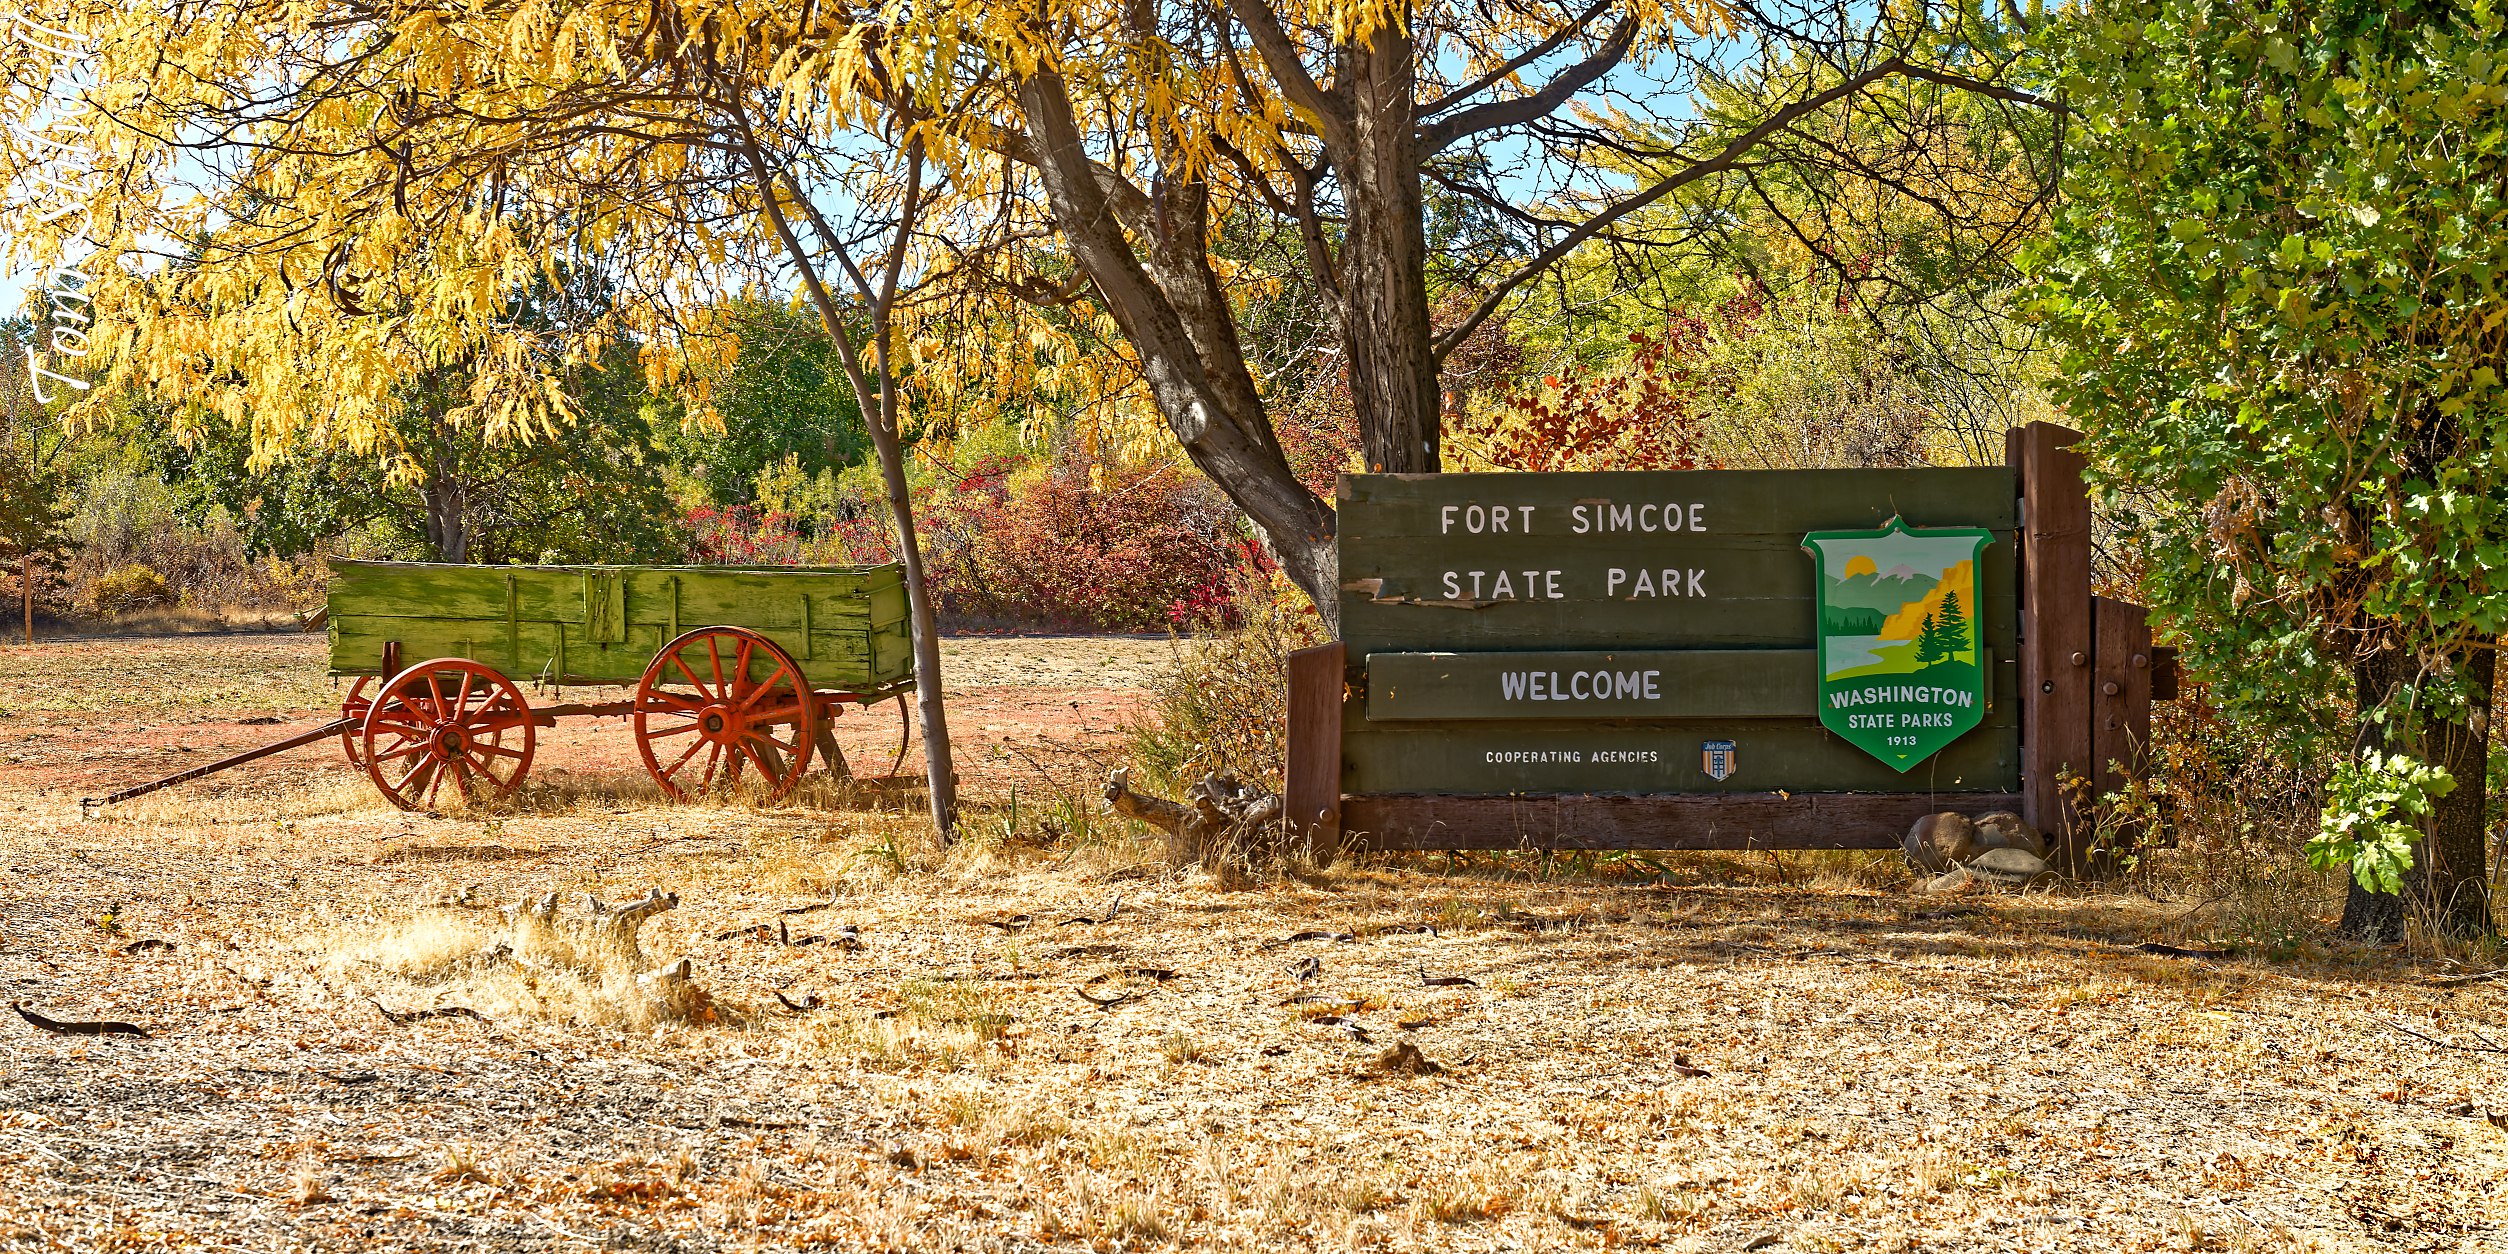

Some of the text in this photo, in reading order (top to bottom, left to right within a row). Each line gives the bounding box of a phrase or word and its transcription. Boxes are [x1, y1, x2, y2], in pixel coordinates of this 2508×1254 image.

[1441, 503, 1707, 534] FORT SIMCOE
[1442, 568, 1707, 599] STATE PARK
[1501, 670, 1661, 701] WELCOME
[1829, 685, 1973, 709] WASHINGTON
[1848, 712, 1953, 729] STATE PARKS
[1887, 736, 1917, 746] 1913
[1486, 751, 1658, 763] COOPERATING AGENCIES
